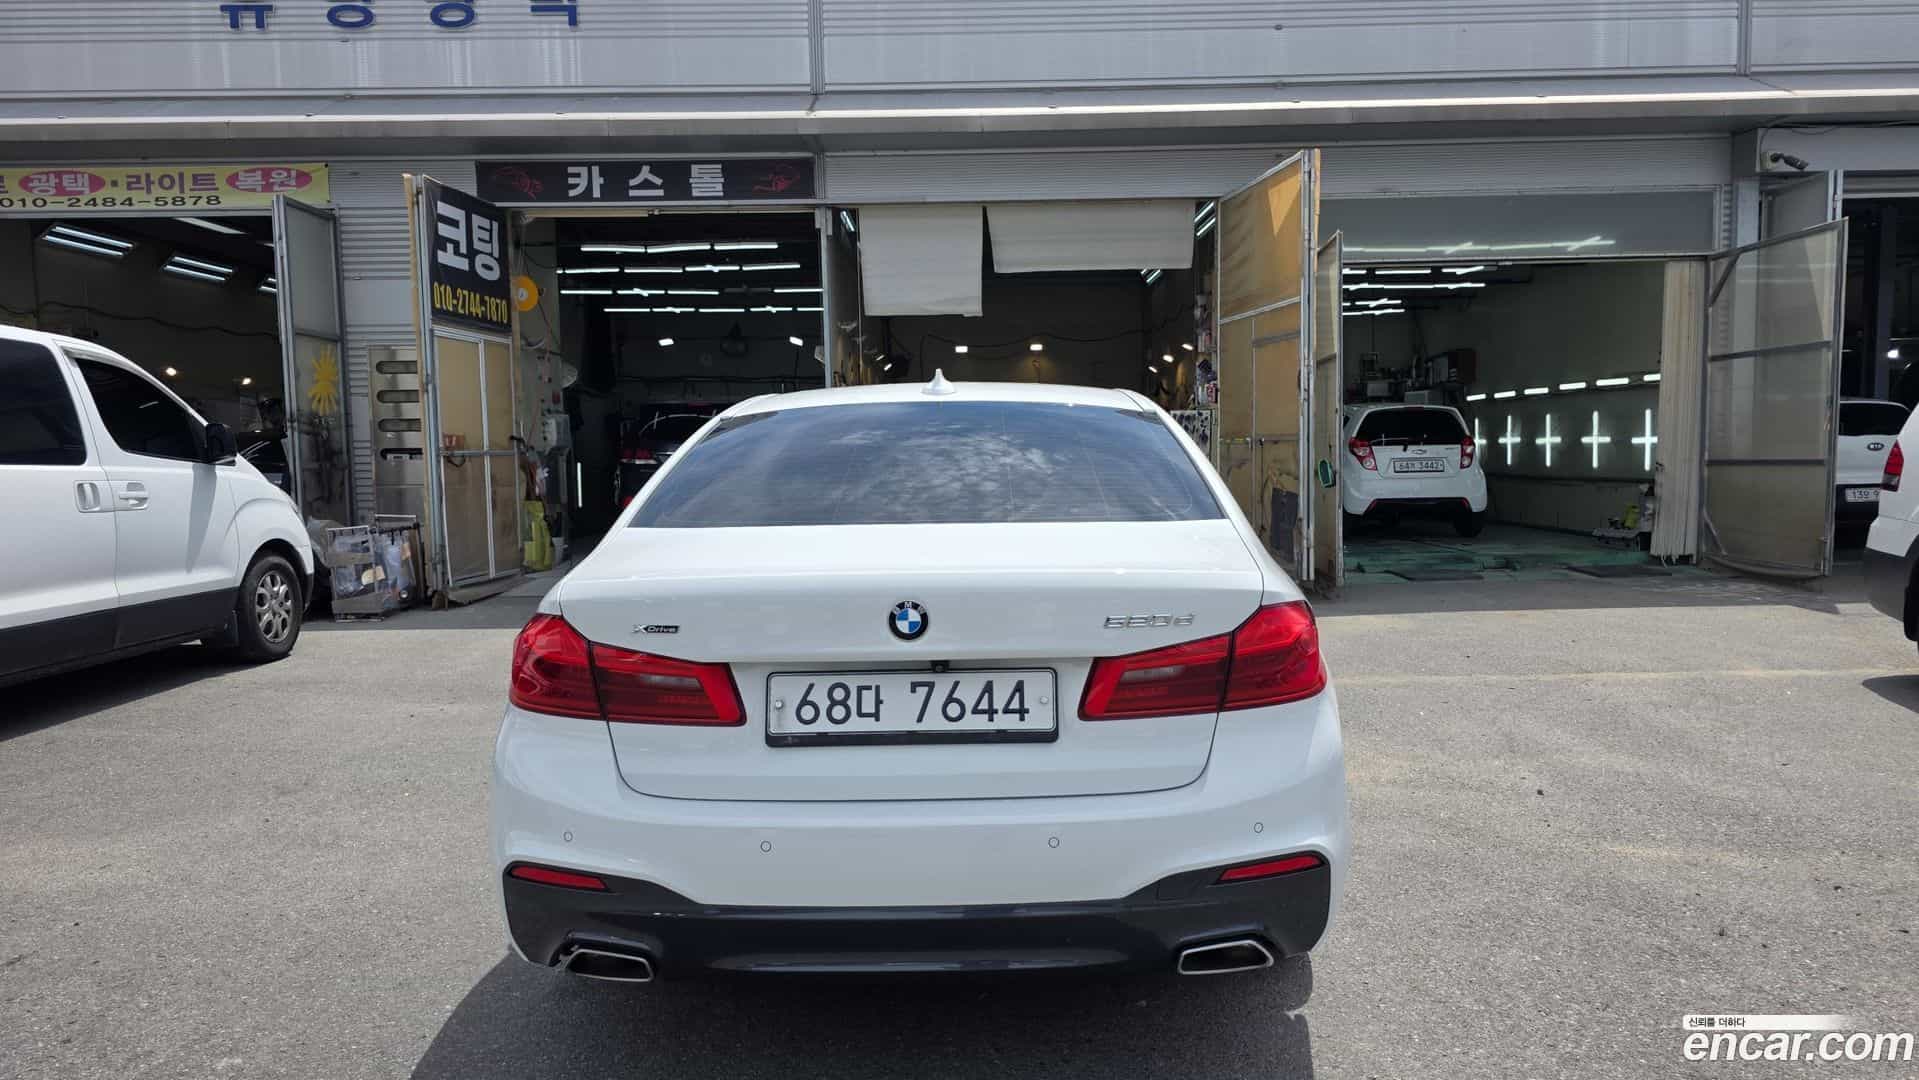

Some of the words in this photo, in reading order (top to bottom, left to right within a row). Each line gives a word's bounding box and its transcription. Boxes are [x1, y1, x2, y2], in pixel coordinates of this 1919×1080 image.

[28, 172, 90, 195] 광택
[235, 169, 298, 190] 복원
[437, 200, 500, 281] 코팅
[433, 281, 508, 324] 010-2744-7870
[795, 682, 884, 725] 68다
[910, 680, 1030, 723] 7644
